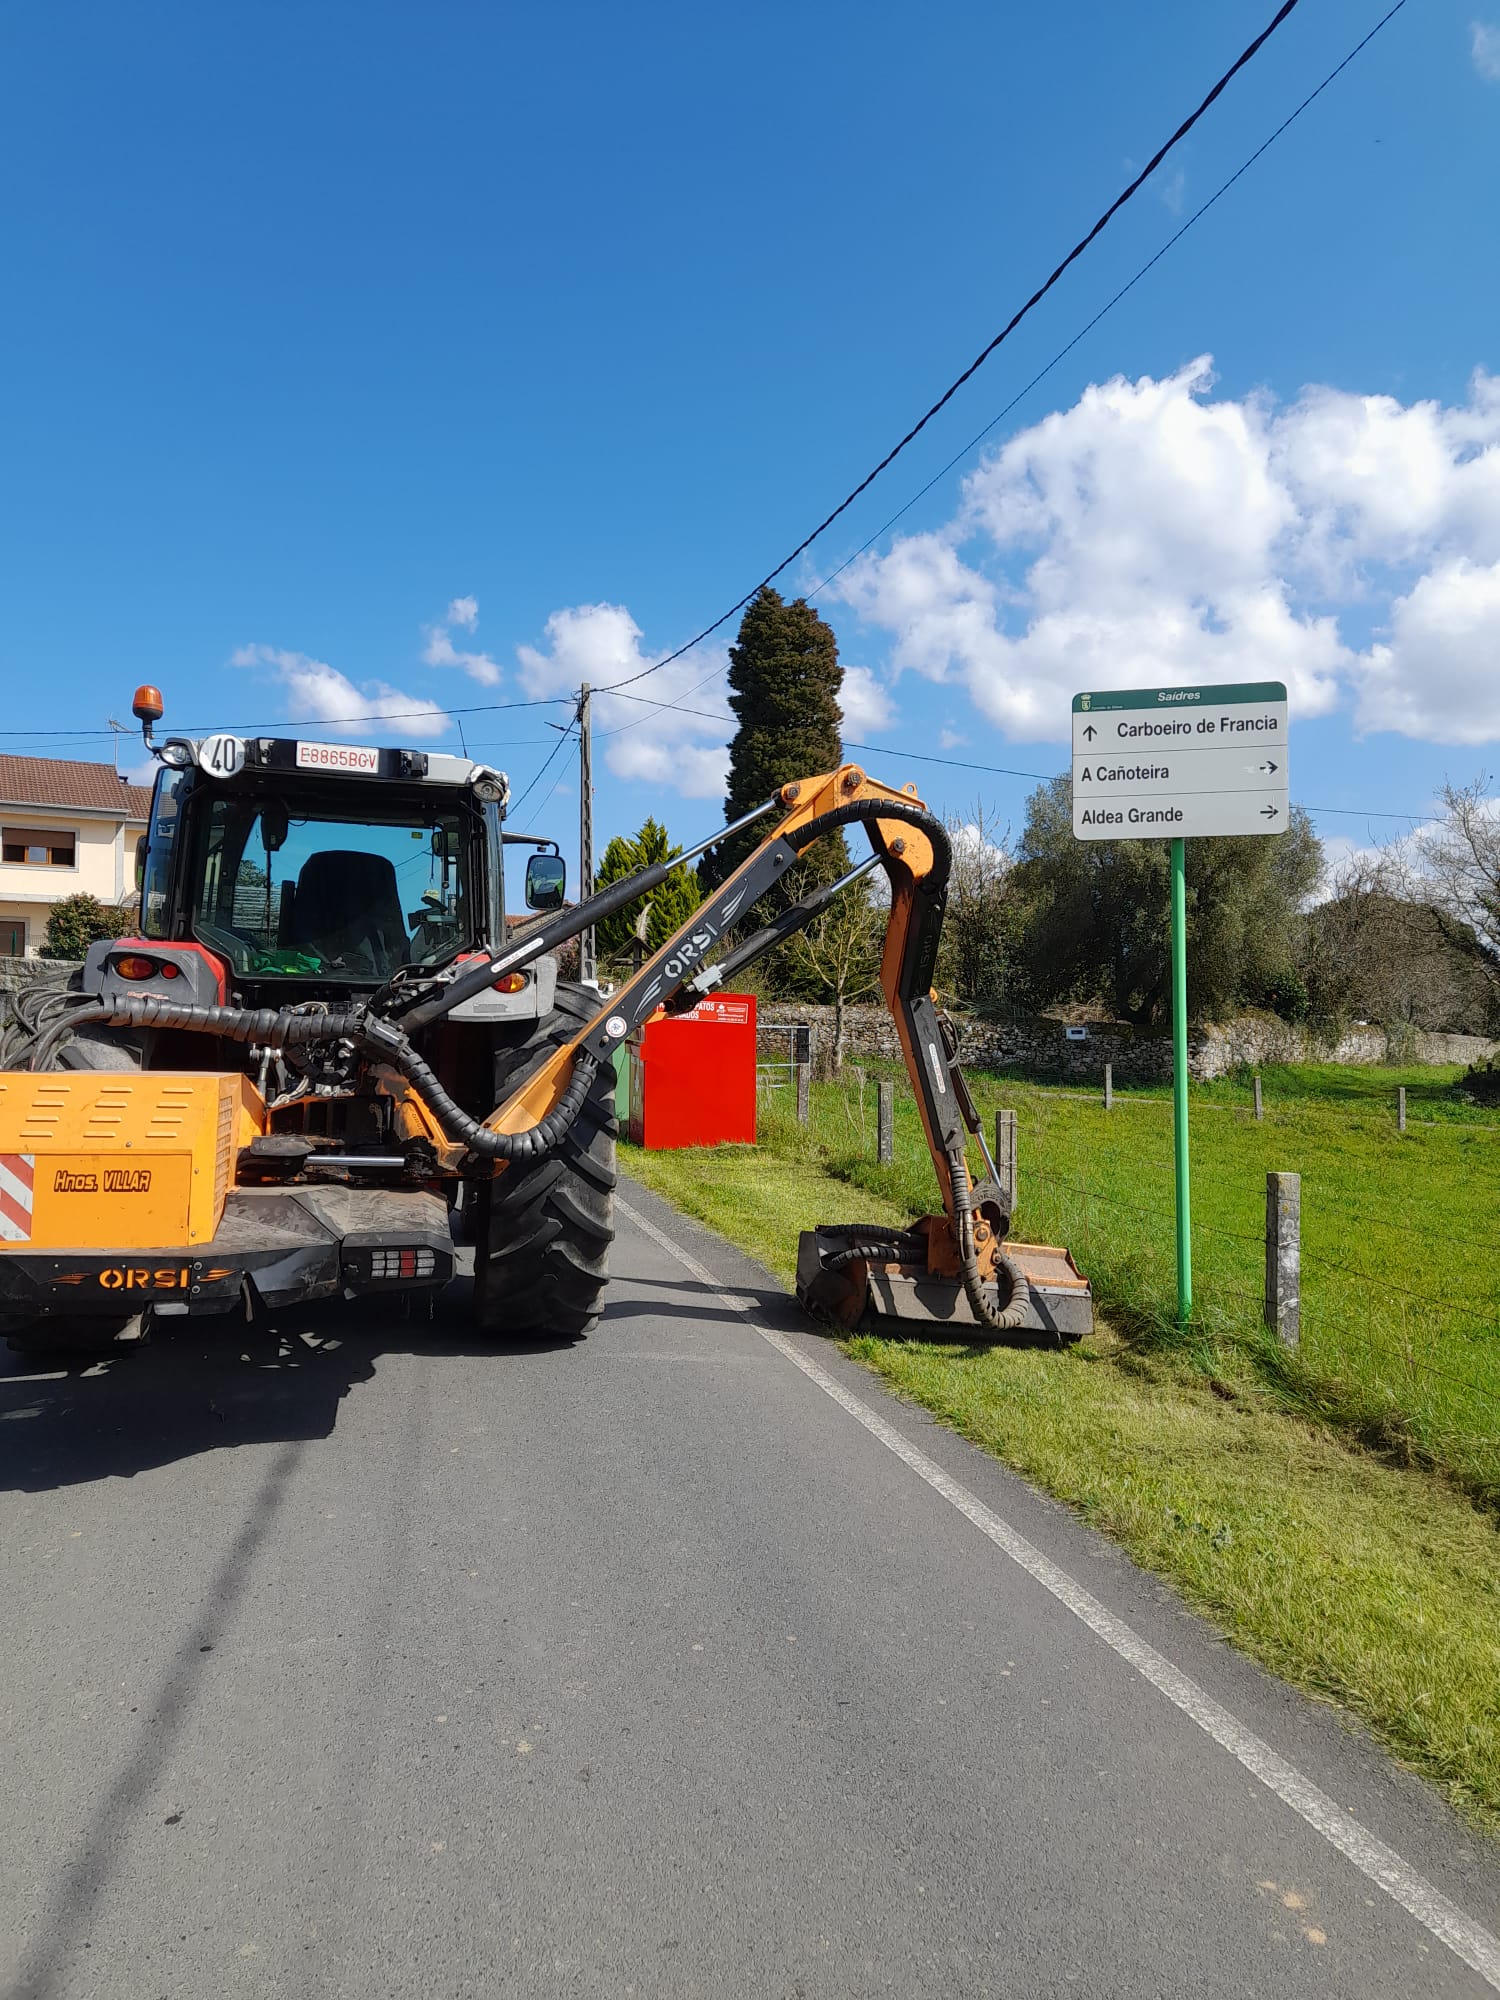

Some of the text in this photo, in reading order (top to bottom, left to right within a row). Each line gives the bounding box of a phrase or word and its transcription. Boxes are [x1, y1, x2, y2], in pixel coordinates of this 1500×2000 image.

[1157, 690, 1201, 702] Saídres
[1117, 715, 1278, 738] Carboeiro de Francia
[211, 738, 236, 772] 40
[300, 747, 377, 769] E8865BGV
[1081, 764, 1170, 782] A Cañoteira
[1081, 807, 1184, 825] Aldea Grande
[664, 922, 718, 978] ORSI
[54, 1170, 151, 1192] Hnos. VILLAR
[99, 1268, 189, 1289] ORSI
